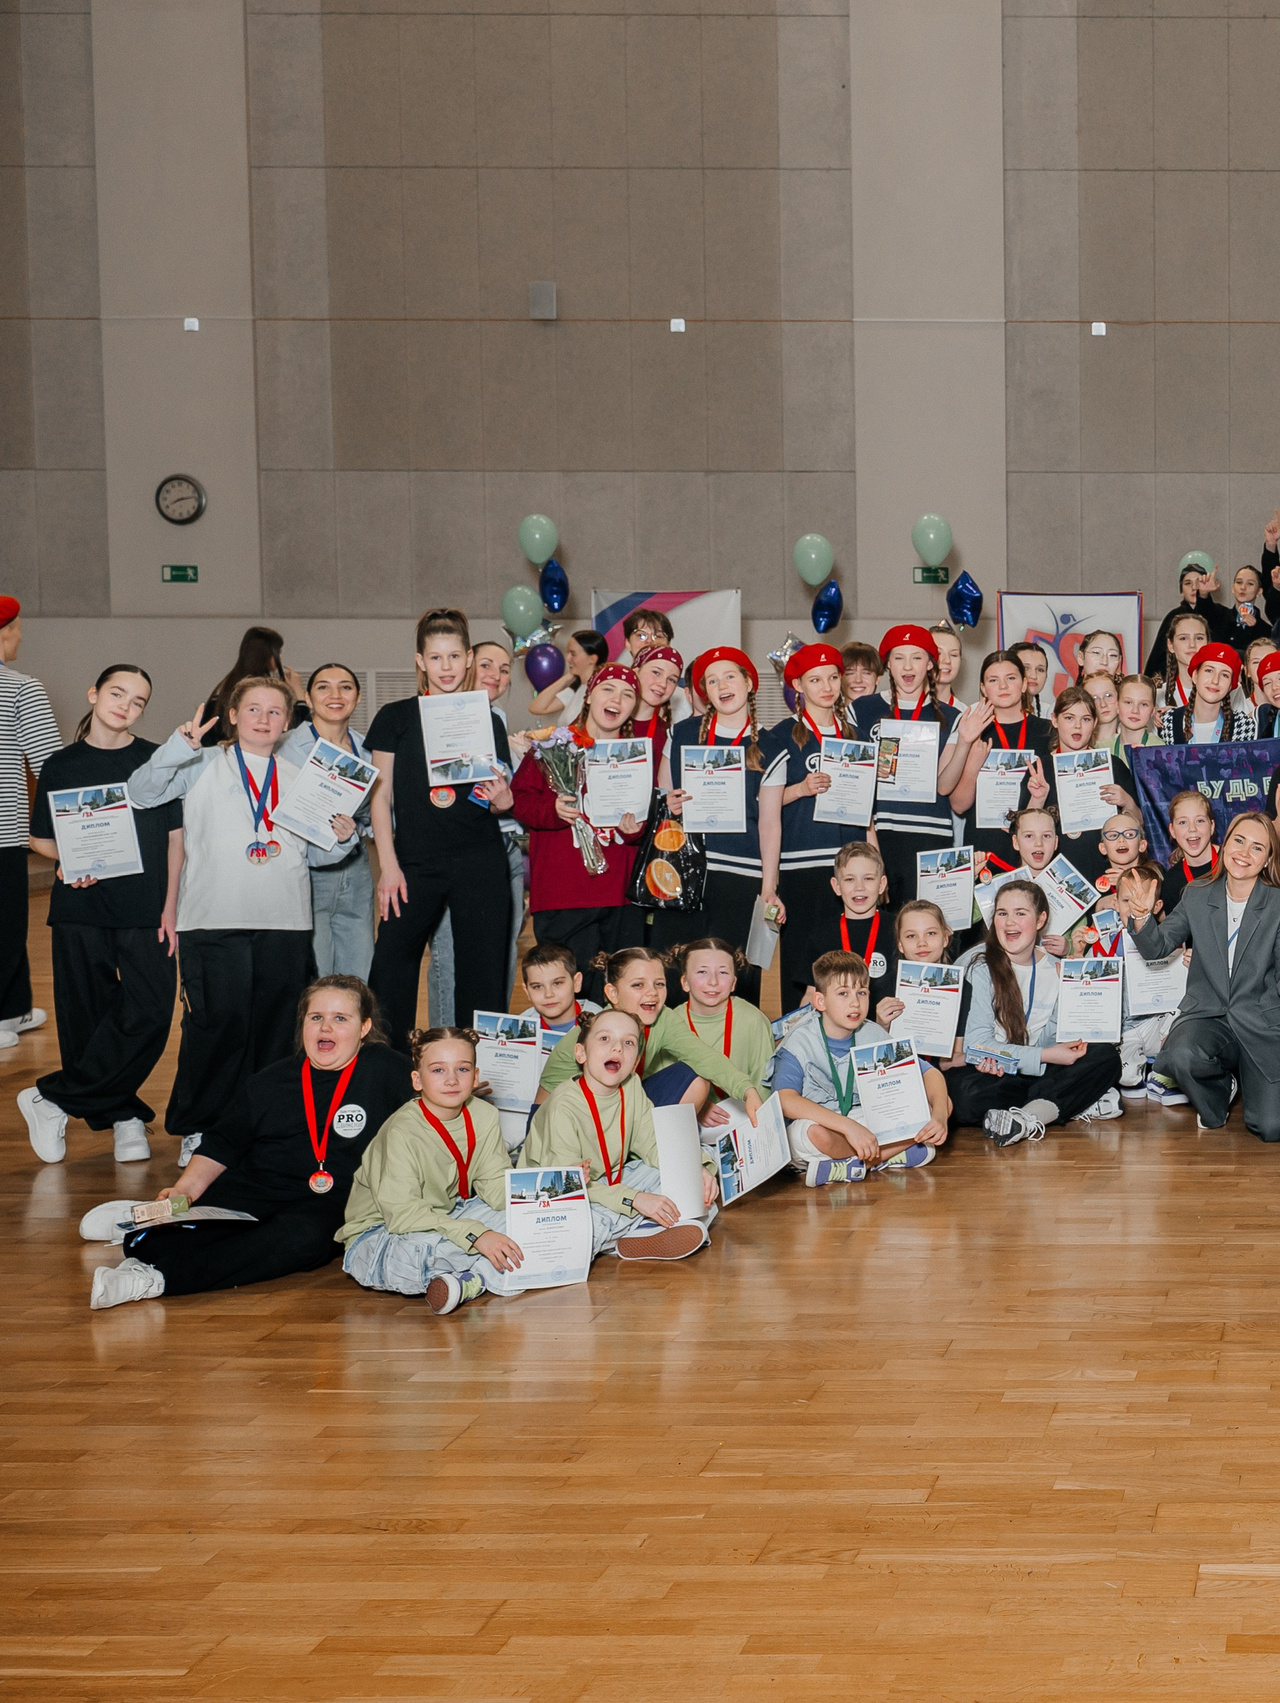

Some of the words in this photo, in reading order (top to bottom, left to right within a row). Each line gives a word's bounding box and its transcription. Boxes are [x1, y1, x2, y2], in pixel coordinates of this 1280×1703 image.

[318, 781, 343, 797] ДИПЛОМ
[1197, 779, 1259, 802] БУДЬ
[81, 822, 111, 831] ДИПЛОМ
[250, 848, 268, 858] FSA
[1146, 960, 1169, 968] ДИПЛОМ
[877, 1079, 902, 1089] ДИПЛОМ
[337, 1113, 364, 1123] PRO
[538, 1200, 550, 1208] FSA
[536, 1215, 567, 1224] ДИПЛОМ
